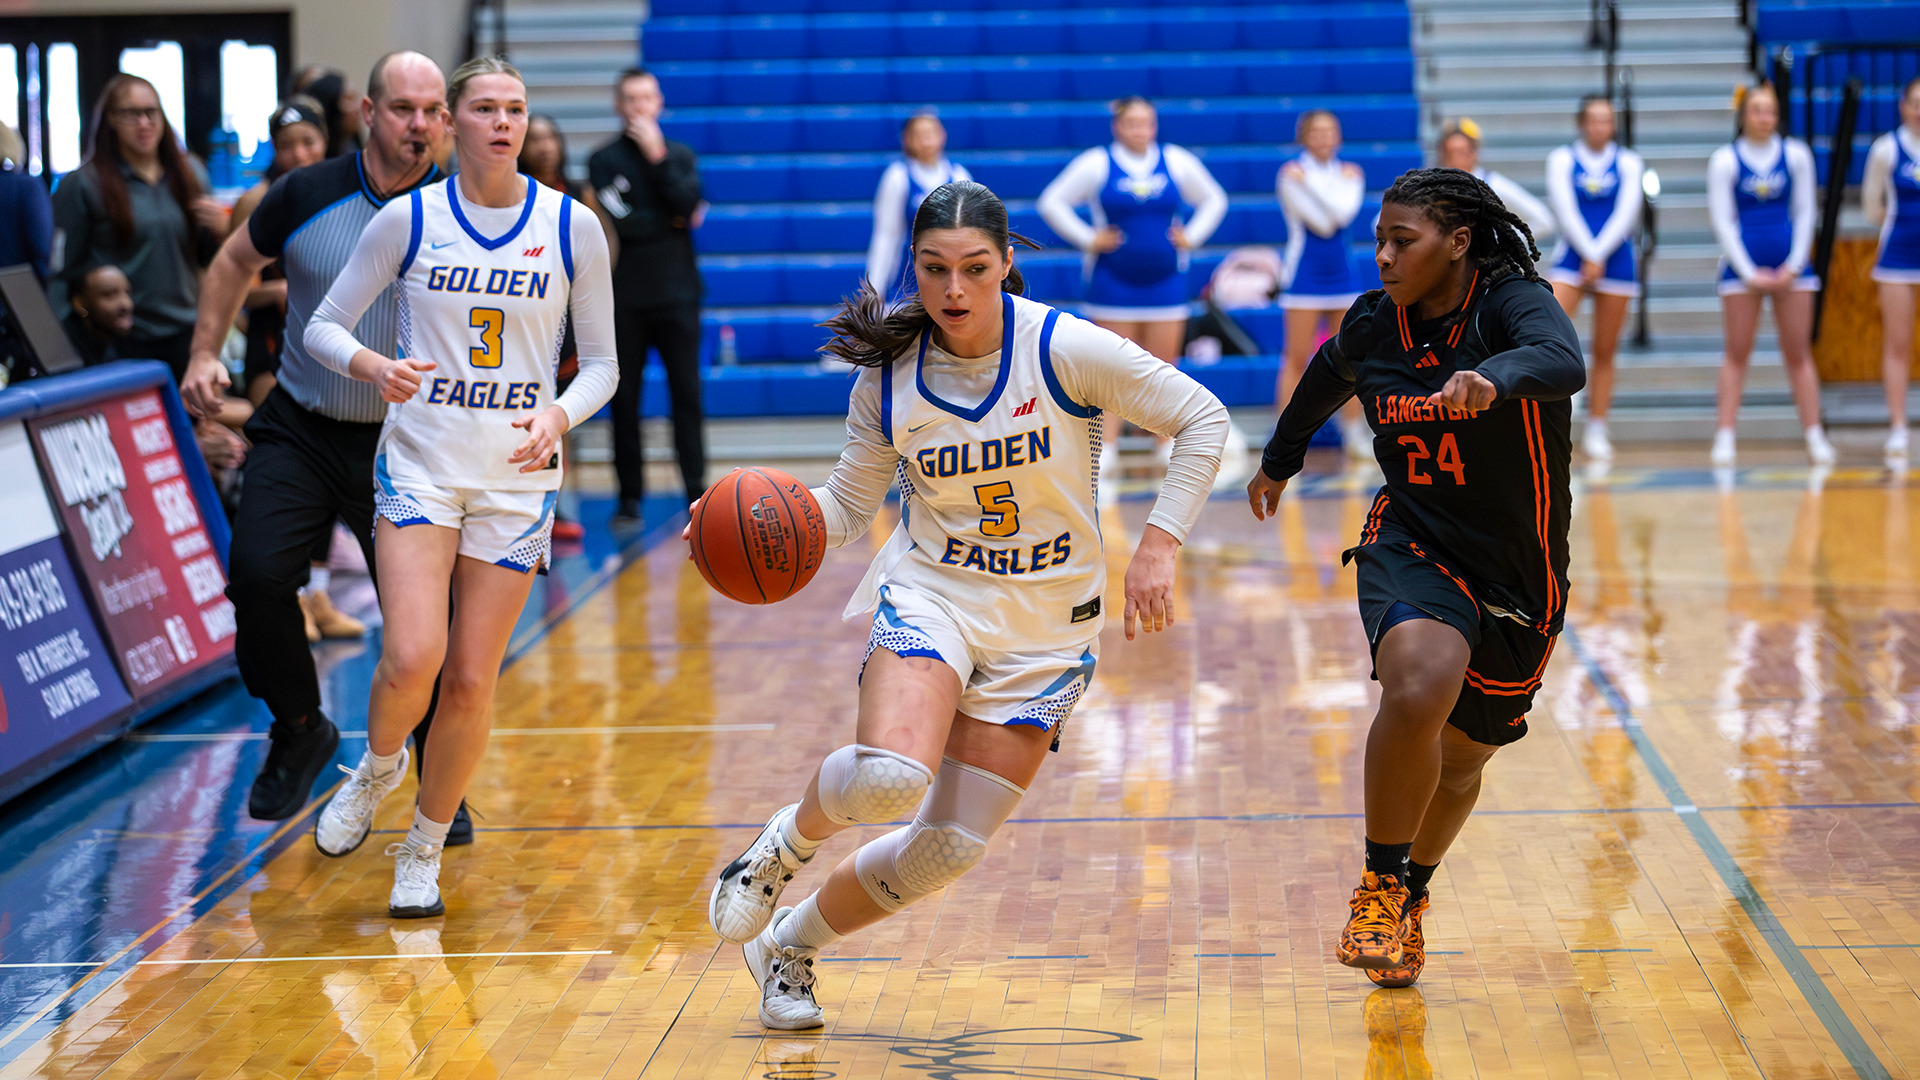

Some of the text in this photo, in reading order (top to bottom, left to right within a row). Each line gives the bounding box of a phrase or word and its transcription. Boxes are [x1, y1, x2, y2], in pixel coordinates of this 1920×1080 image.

[428, 266, 550, 299] GOLDEN
[468, 306, 505, 368] 3
[428, 378, 541, 410] EAGLES
[917, 426, 1052, 478] GOLDEN
[1397, 433, 1466, 485] 24
[759, 494, 790, 573] LEGACY
[784, 484, 819, 570] SPALDING
[973, 480, 1020, 538] 5
[940, 531, 1072, 575] EAGLES
